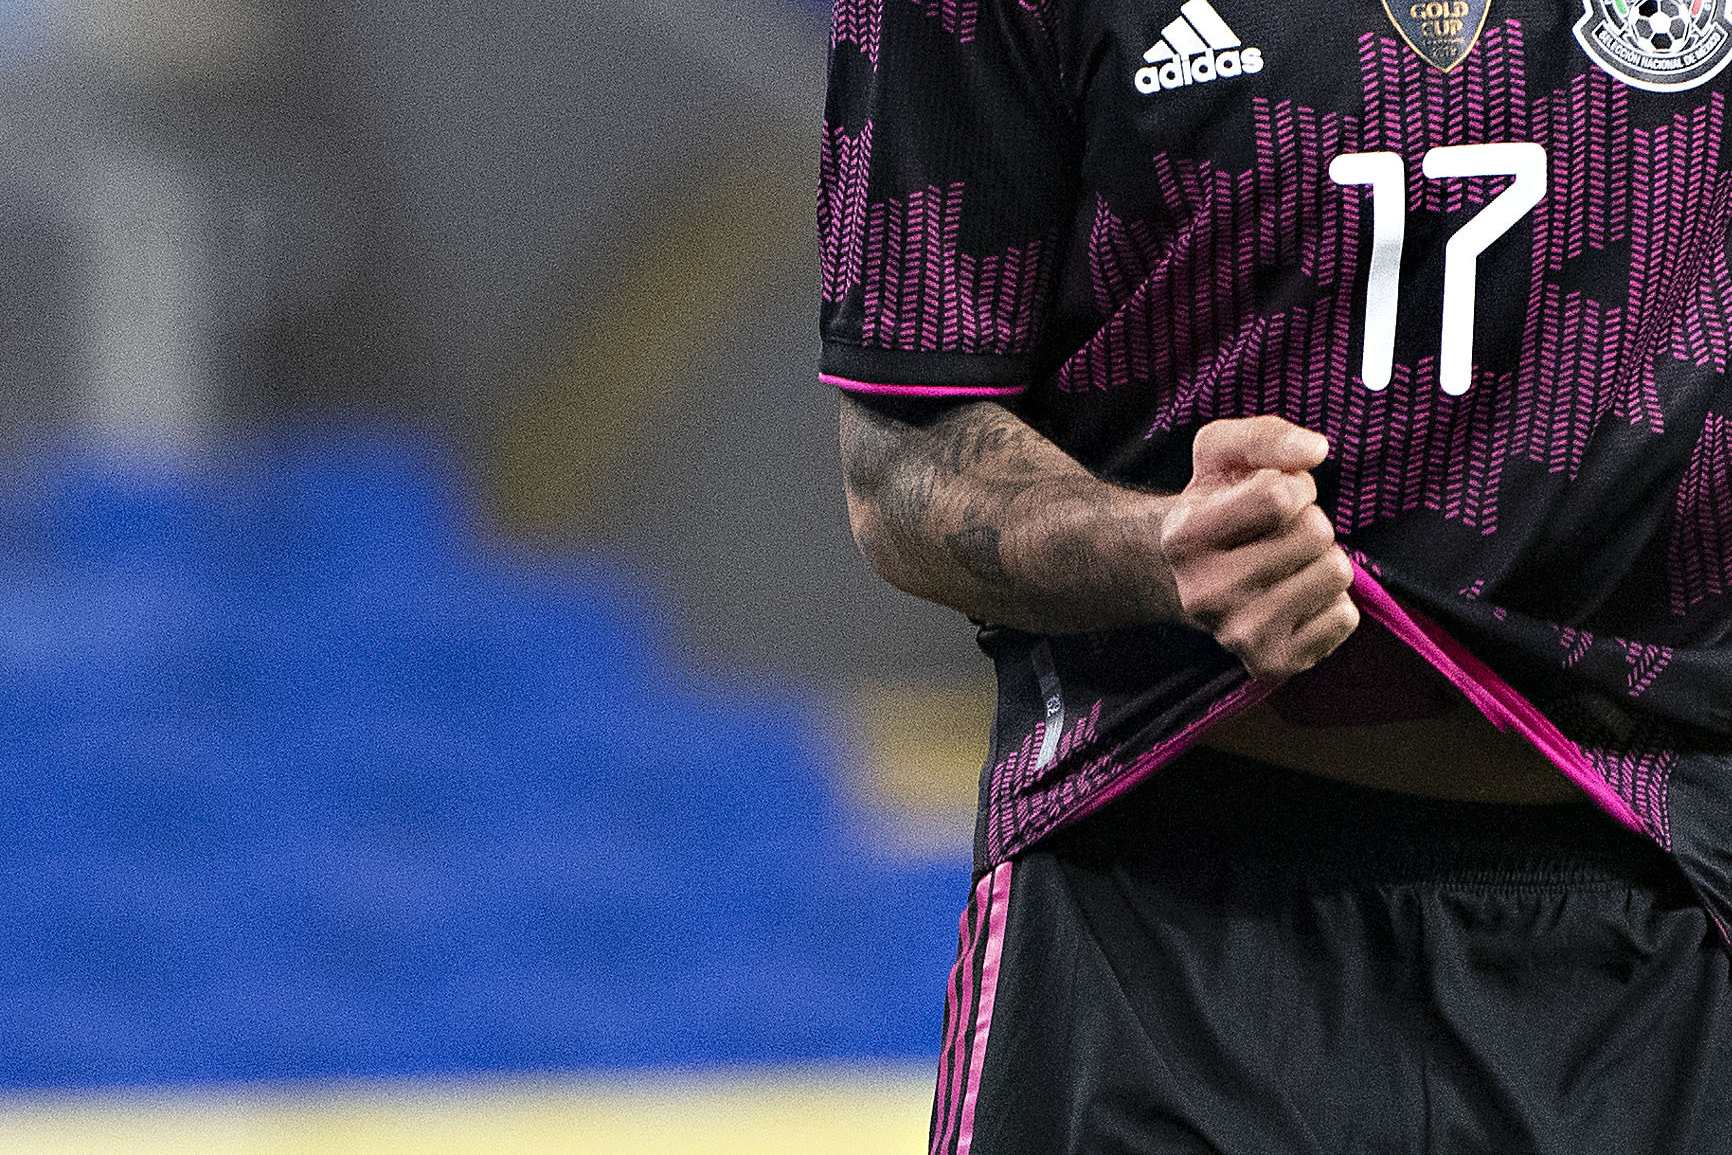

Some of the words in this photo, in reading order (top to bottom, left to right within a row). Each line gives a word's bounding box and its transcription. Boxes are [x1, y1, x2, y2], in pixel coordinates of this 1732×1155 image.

[1410, 1, 1469, 20] GOLD
[1421, 19, 1463, 36] CUP
[1134, 47, 1264, 94] adidas
[1328, 142, 1547, 396] 17
